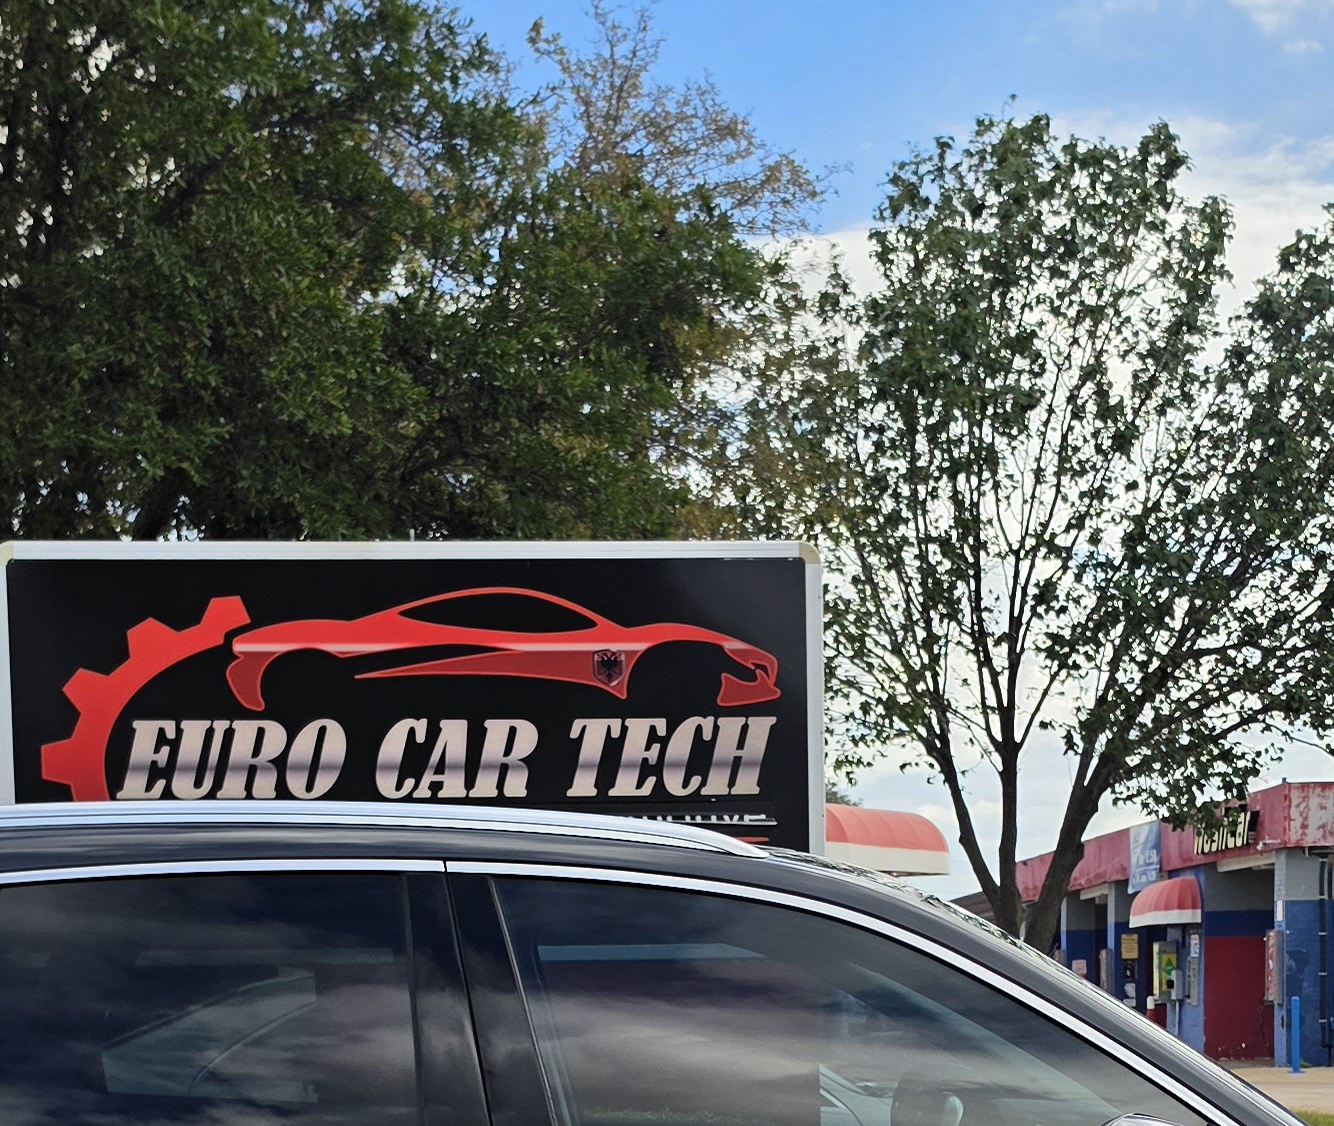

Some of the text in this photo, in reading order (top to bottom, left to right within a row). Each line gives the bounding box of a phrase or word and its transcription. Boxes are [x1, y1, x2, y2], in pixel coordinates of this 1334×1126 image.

[117, 716, 777, 800] EURO CAR TECH
